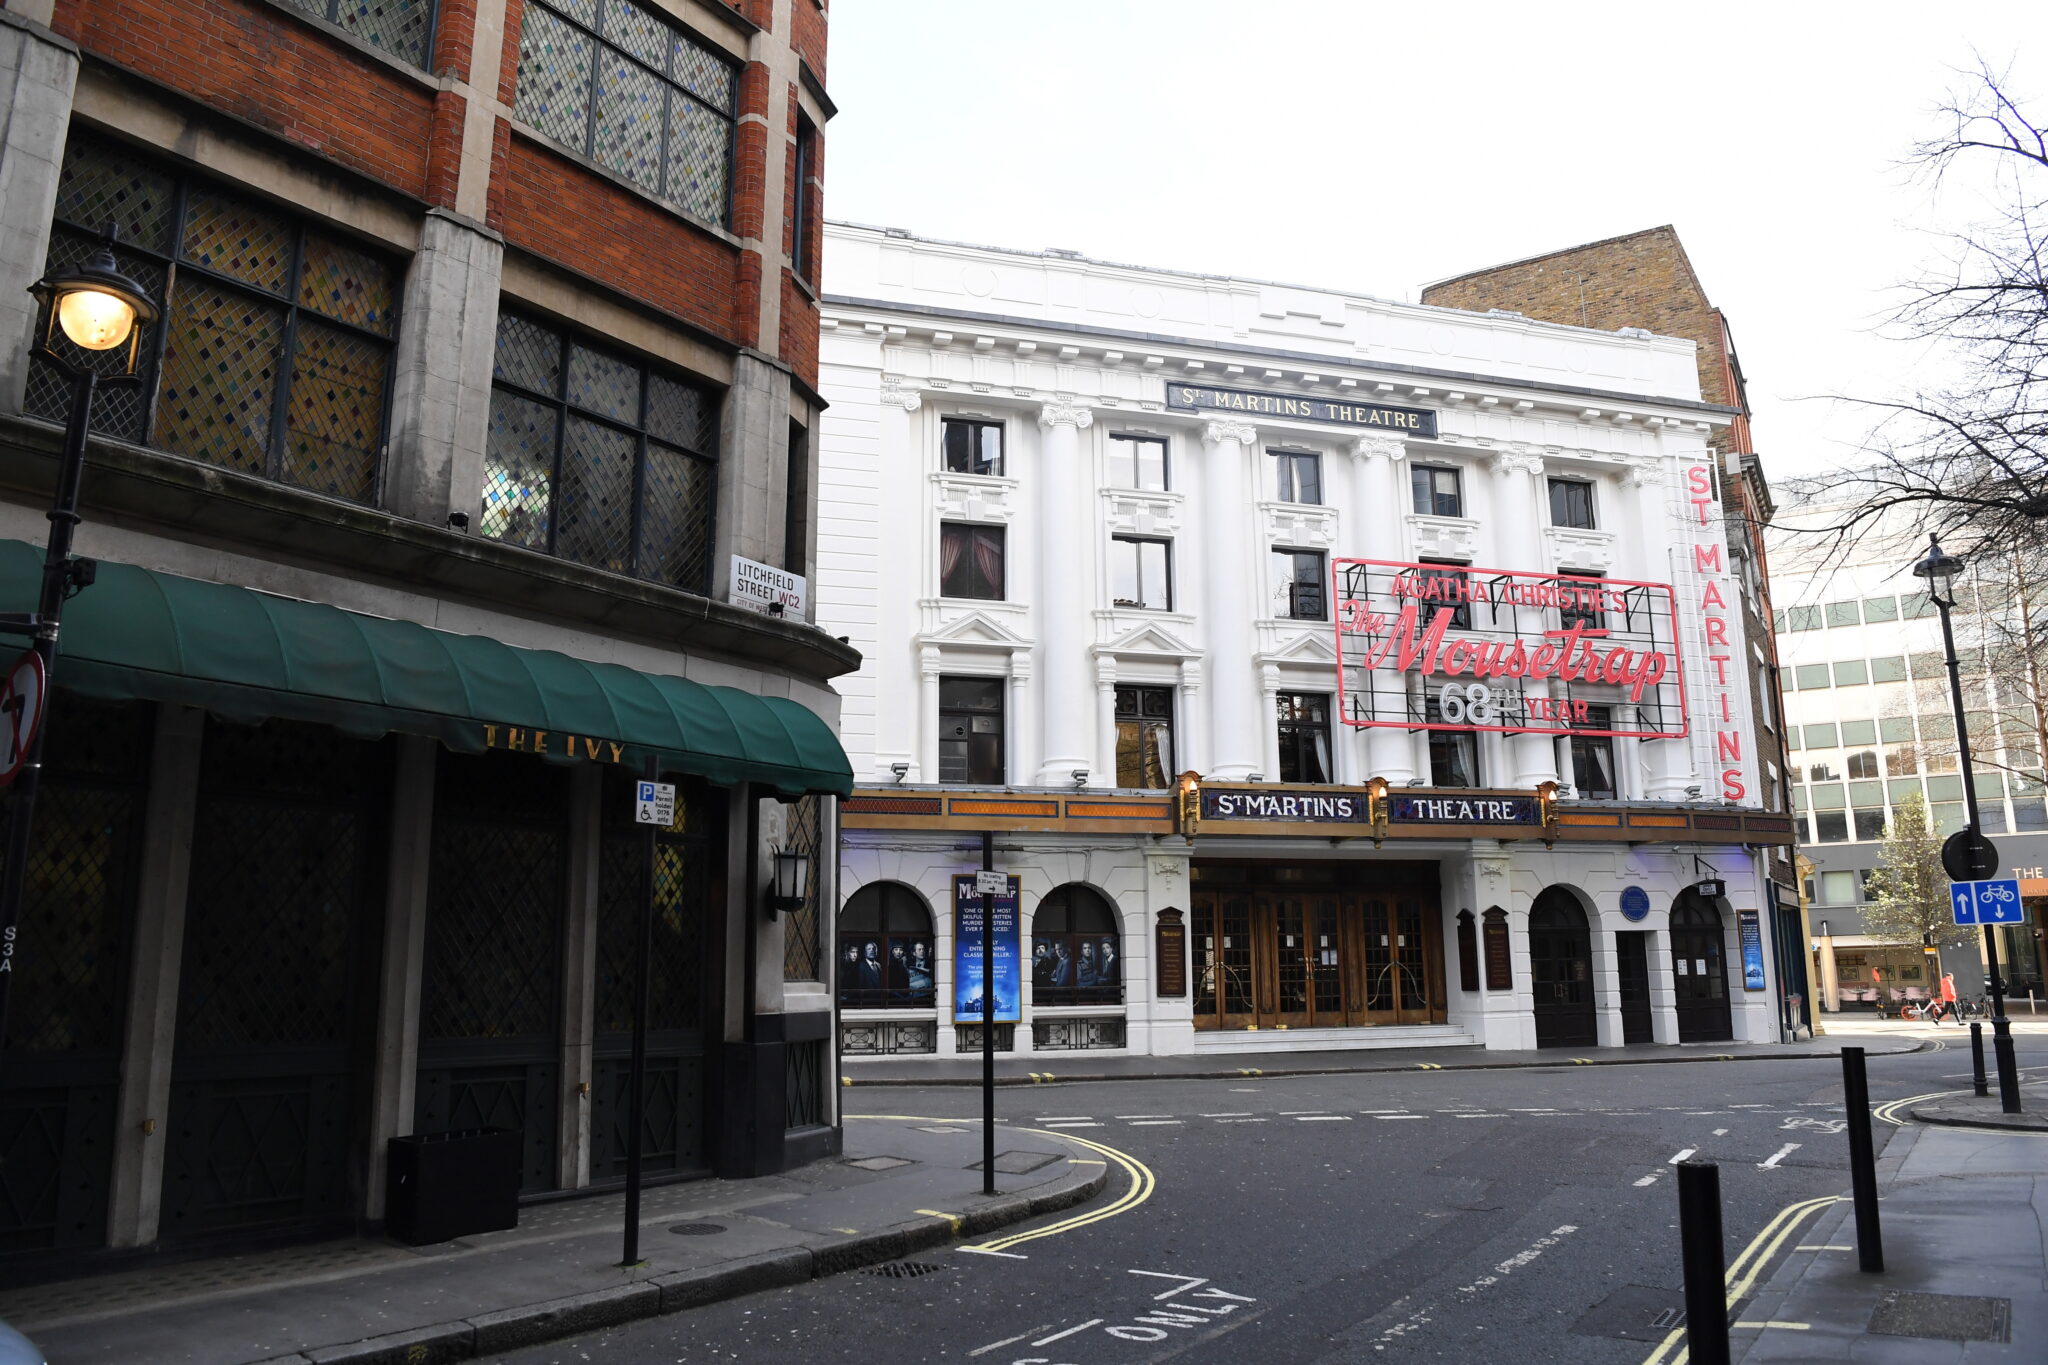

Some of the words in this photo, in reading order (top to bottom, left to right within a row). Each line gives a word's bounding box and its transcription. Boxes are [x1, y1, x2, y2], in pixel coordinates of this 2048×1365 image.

[1214, 391, 1312, 416] MARTINS
[1326, 403, 1421, 429] THEATRE
[737, 578, 775, 600] STREET
[779, 590, 800, 609] WC2
[738, 562, 794, 591] LITCHFIELD
[1391, 573, 1491, 604] AGATHA
[1503, 581, 1628, 614] CHRISTIE'S
[1340, 600, 1387, 634] The
[1364, 604, 1667, 703] Mousetrap
[1695, 543, 1745, 800] MARTINS
[1523, 696, 1590, 724] YEAR
[483, 724, 548, 753] THE
[567, 735, 625, 764] IVY
[643, 785, 653, 799] P
[1412, 799, 1516, 820] THEATRE
[2011, 867, 2044, 879] THE
[1105, 1288, 1257, 1342] ONLY
